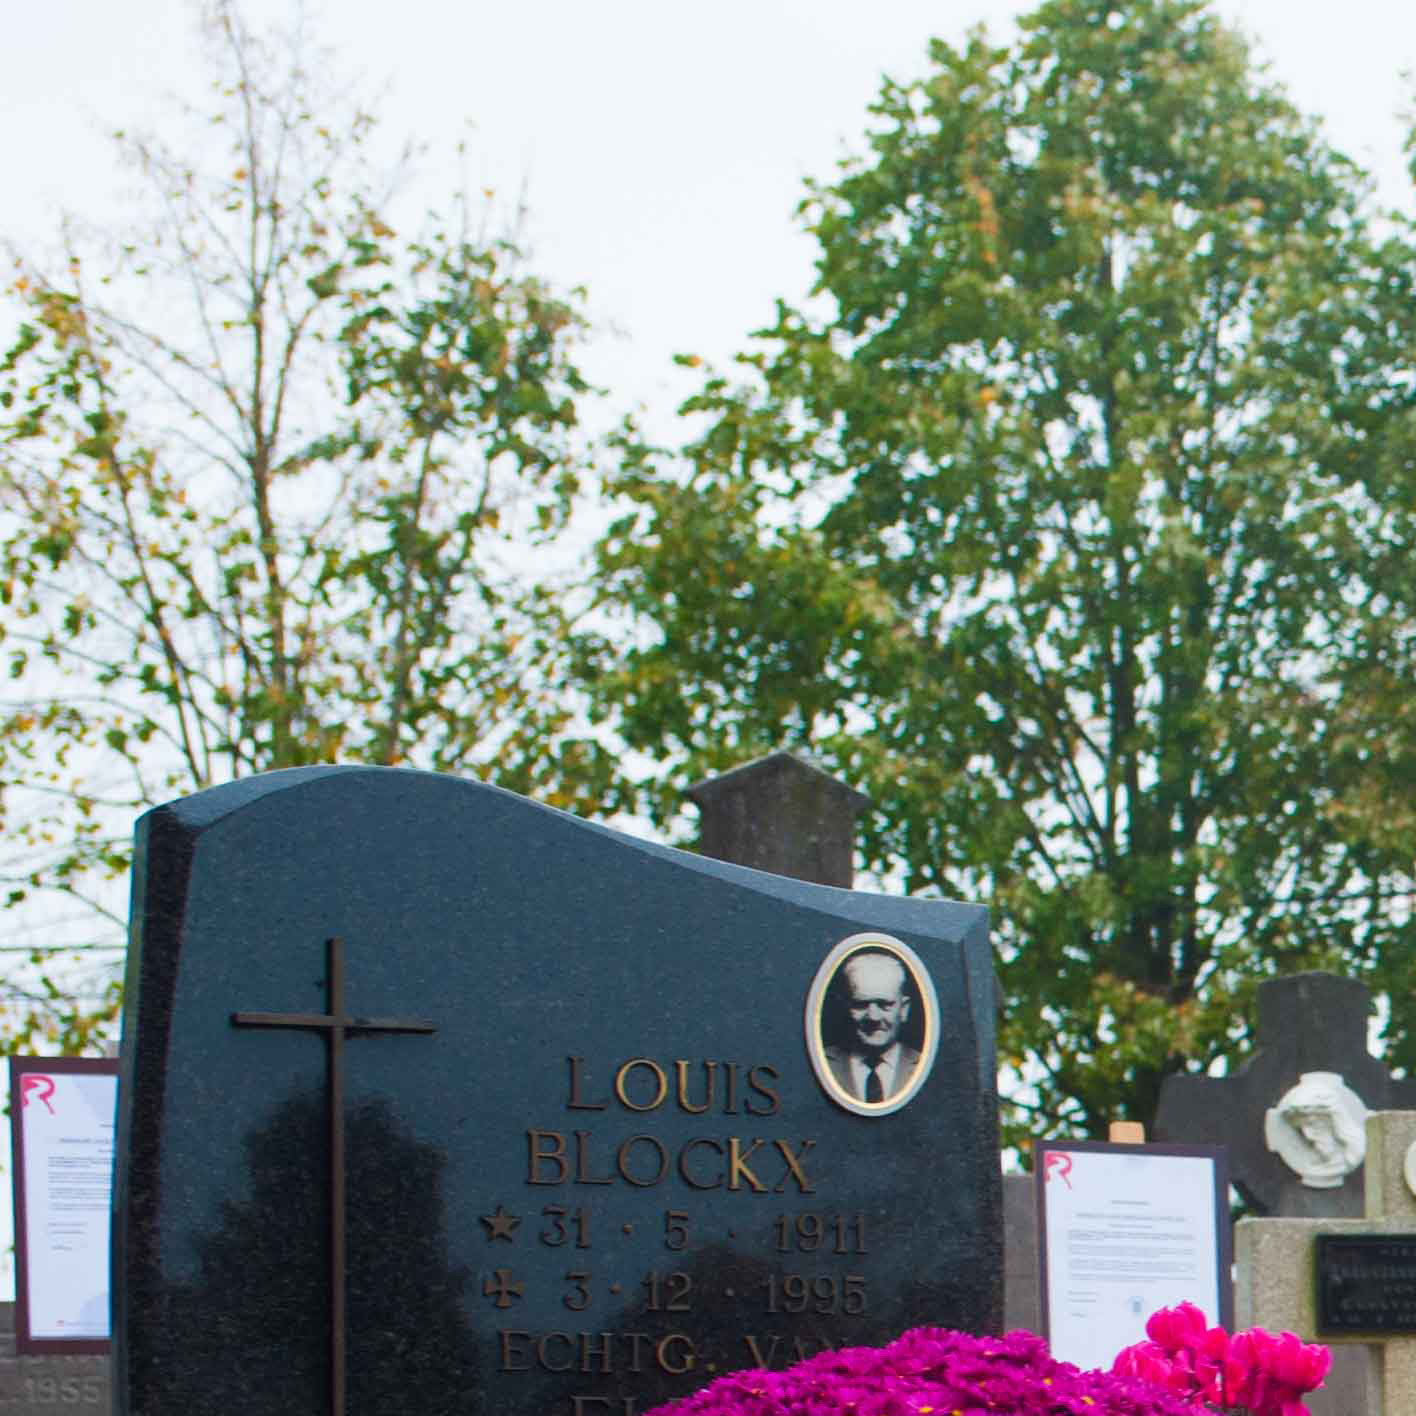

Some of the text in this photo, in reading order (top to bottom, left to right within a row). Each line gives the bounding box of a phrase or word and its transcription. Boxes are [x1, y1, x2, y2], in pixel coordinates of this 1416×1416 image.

[565, 1055, 780, 1117] LOUIS
[525, 1126, 817, 1195] BLOCKX
[542, 1203, 593, 1248] 31
[663, 1208, 691, 1251] 5
[773, 1213, 870, 1255] 1911
[563, 1270, 593, 1312] 3
[641, 1271, 693, 1312] 12
[766, 1273, 867, 1315] 1995
